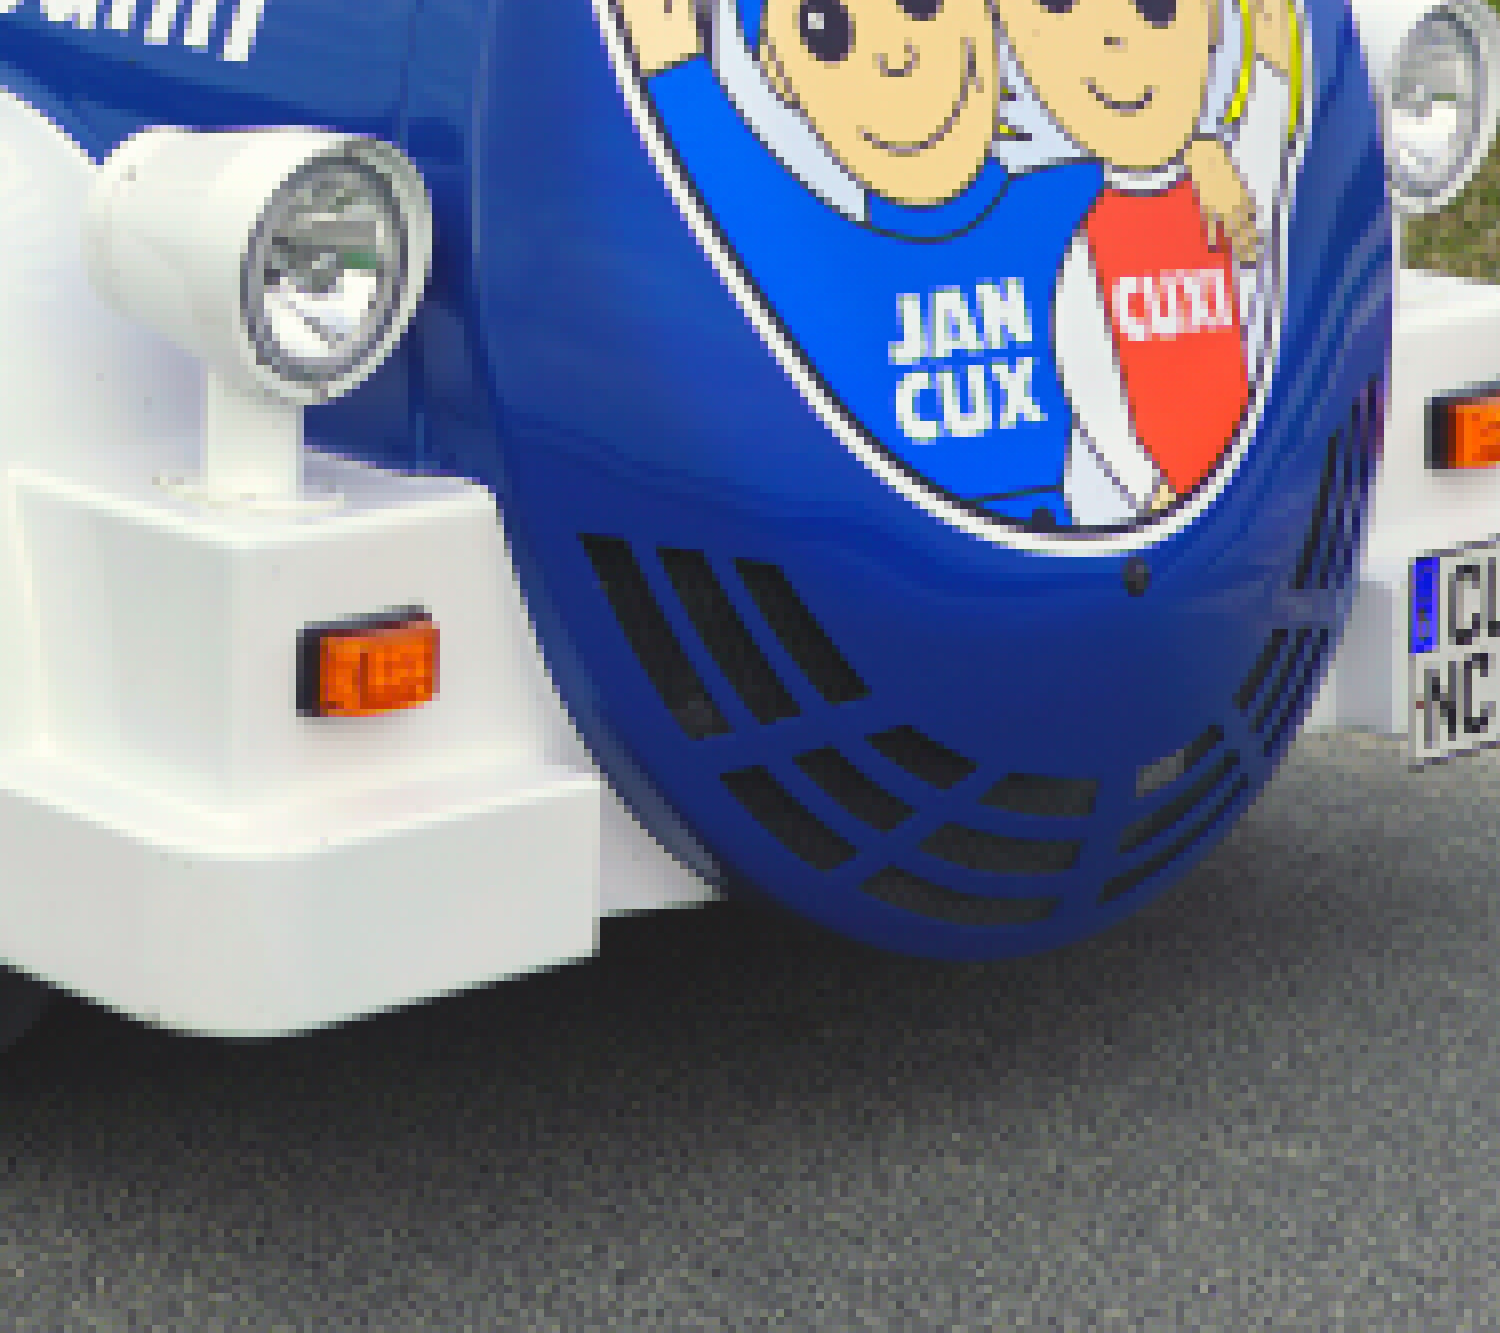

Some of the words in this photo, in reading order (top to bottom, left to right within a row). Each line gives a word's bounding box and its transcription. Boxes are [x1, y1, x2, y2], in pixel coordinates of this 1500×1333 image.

[889, 276, 1034, 365] JAN
[1112, 267, 1232, 343] CUXI
[894, 355, 1049, 445] CUX
[1422, 650, 1497, 751] NC
